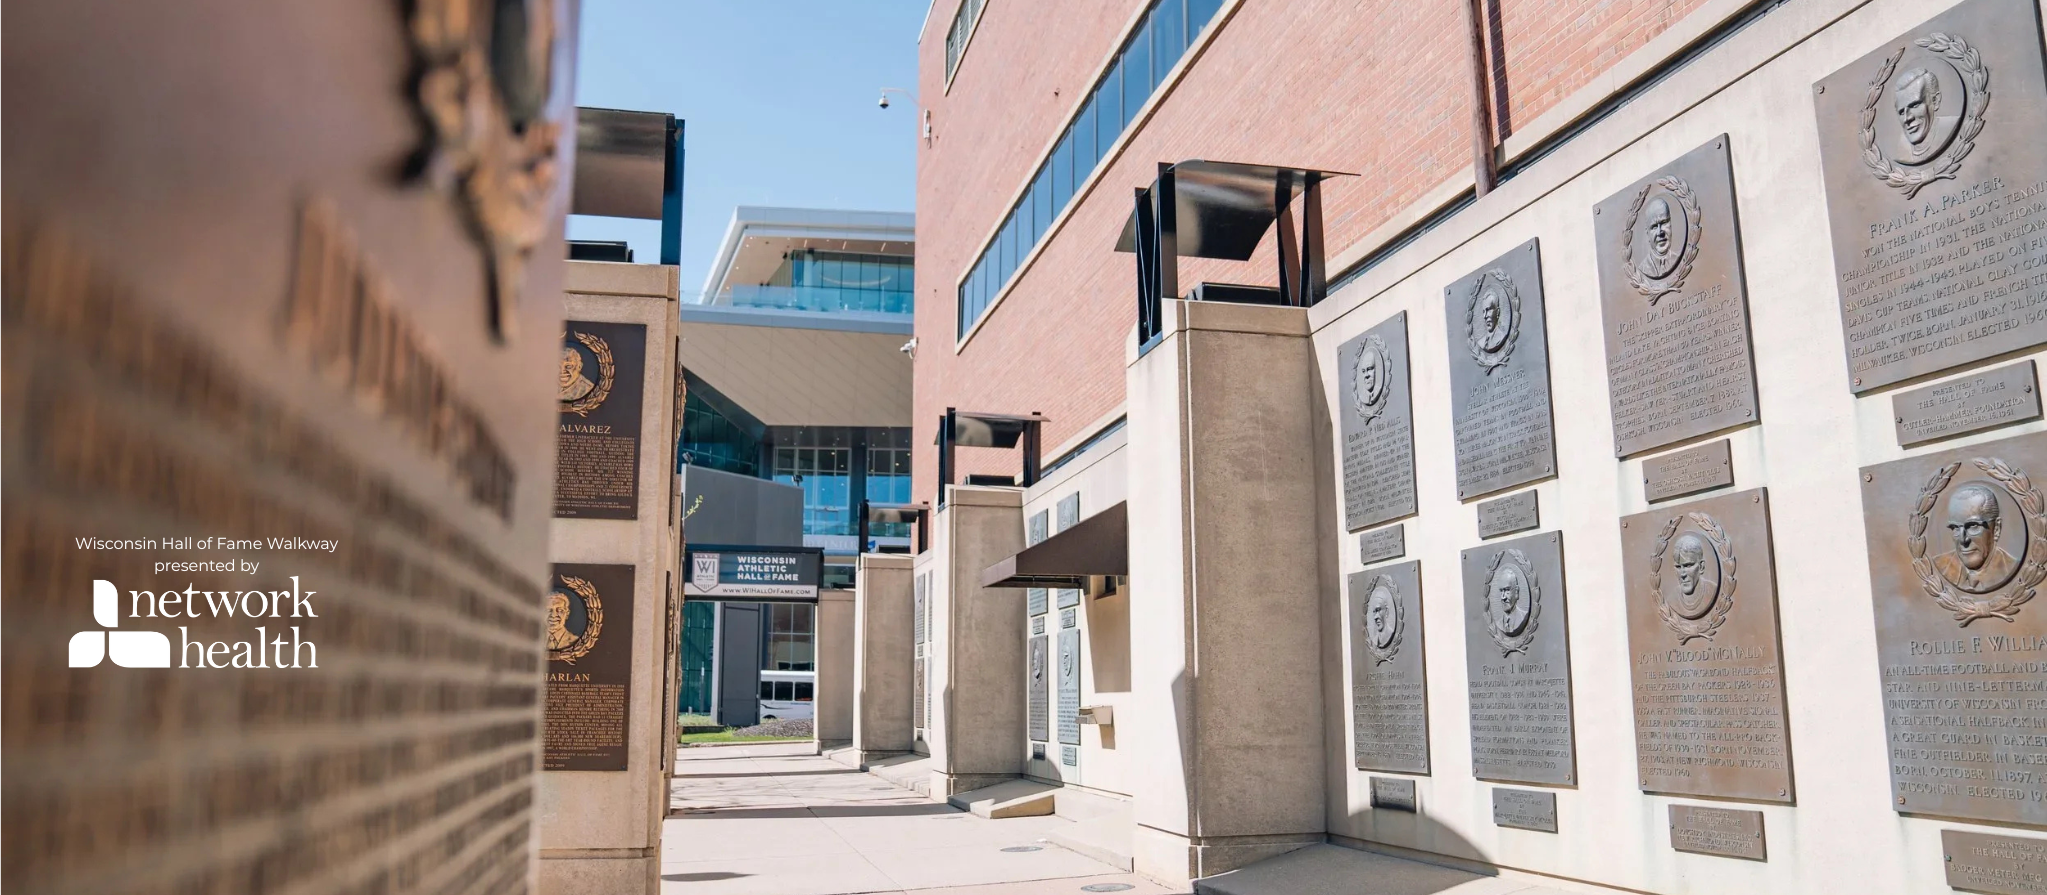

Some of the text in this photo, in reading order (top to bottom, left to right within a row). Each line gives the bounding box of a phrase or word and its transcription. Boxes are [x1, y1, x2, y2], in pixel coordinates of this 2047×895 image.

[1870, 175, 2005, 238] FRANK A. PARKER
[1862, 242, 1884, 259] WON
[1887, 234, 1906, 249] THE
[1909, 211, 1965, 241] NATIONAL
[2003, 179, 2047, 206] TENNI
[1841, 247, 1915, 283] CHAMPIONSHIP
[1919, 241, 1931, 254] IN
[1962, 220, 1985, 238] THE
[1843, 278, 1876, 298] JUNIOR
[1879, 267, 1905, 284] TITLE
[1908, 262, 1919, 274] IN
[1921, 253, 1944, 270] 1932
[1946, 244, 1970, 261] AND
[1972, 235, 1995, 252] THE
[1844, 291, 1883, 313] SINGLES
[1886, 287, 1896, 298] IN
[1957, 249, 2004, 274] PLAYED
[2008, 242, 2026, 257] ON
[1847, 311, 1872, 328] DAVIS
[1875, 304, 1893, 318] CUP
[1931, 274, 1984, 300] NATIONAL
[1987, 262, 2018, 282] CLAY
[1618, 284, 1722, 335] JOHN DAY BUCKSTAFF
[1849, 319, 1896, 343] CHAMPION
[1899, 311, 1922, 327] FIVE
[1924, 301, 1954, 319] TIMES
[1956, 293, 1978, 309] AND
[1982, 278, 2028, 301] FRENCH
[1957, 302, 2007, 327] JANUARY
[1966, 316, 2020, 341] ELECTED
[1975, 377, 1985, 386] TO
[1917, 381, 2005, 409] THE HALL OF FAME
[1973, 395, 2026, 415] FOUNDATION
[560, 424, 612, 434] ALVAREZ
[696, 560, 715, 574] WI
[737, 556, 796, 564] WISCONSIN
[737, 565, 787, 573] ATHLETIC
[1909, 638, 1965, 655] ROLLIE
[1971, 637, 1982, 653] F.
[1637, 652, 1662, 664] JOHN
[1665, 650, 1673, 662] V.
[1673, 648, 1712, 662] "BLOOD"
[1885, 666, 1899, 676] AN
[1901, 664, 1949, 675] ALL-TIME
[1951, 663, 2010, 674] FOOTBALL
[2011, 662, 2038, 673] AND
[1682, 682, 1696, 690] BAY
[1886, 681, 2047, 692] STAR AND NINE-LETTERM
[1651, 695, 1664, 704] THE
[1666, 694, 1708, 704] PITTSBURGH
[1710, 694, 1748, 703] STEELERS
[1888, 698, 1944, 710] UNIVERSITY
[1944, 699, 1959, 709] OF
[1962, 699, 2021, 710] WISCONSIN
[1890, 714, 2046, 728] A SENSATIONAL HALFBACK IN
[1702, 732, 1716, 740] THE
[1892, 731, 1899, 741] A
[1901, 731, 1937, 743] GREAT
[1941, 732, 1981, 745] GUARD
[1985, 734, 1997, 744] IN
[1893, 748, 1917, 759] FINE
[1995, 752, 2008, 763] IN
[1967, 784, 2025, 801] ELECTED
[1971, 846, 1989, 856] THE
[1991, 849, 2017, 859] HALL
[2019, 852, 2032, 861] OF
[2033, 844, 2045, 853] TO
[1949, 863, 1985, 874] BADGER
[1987, 867, 2018, 879] METER
